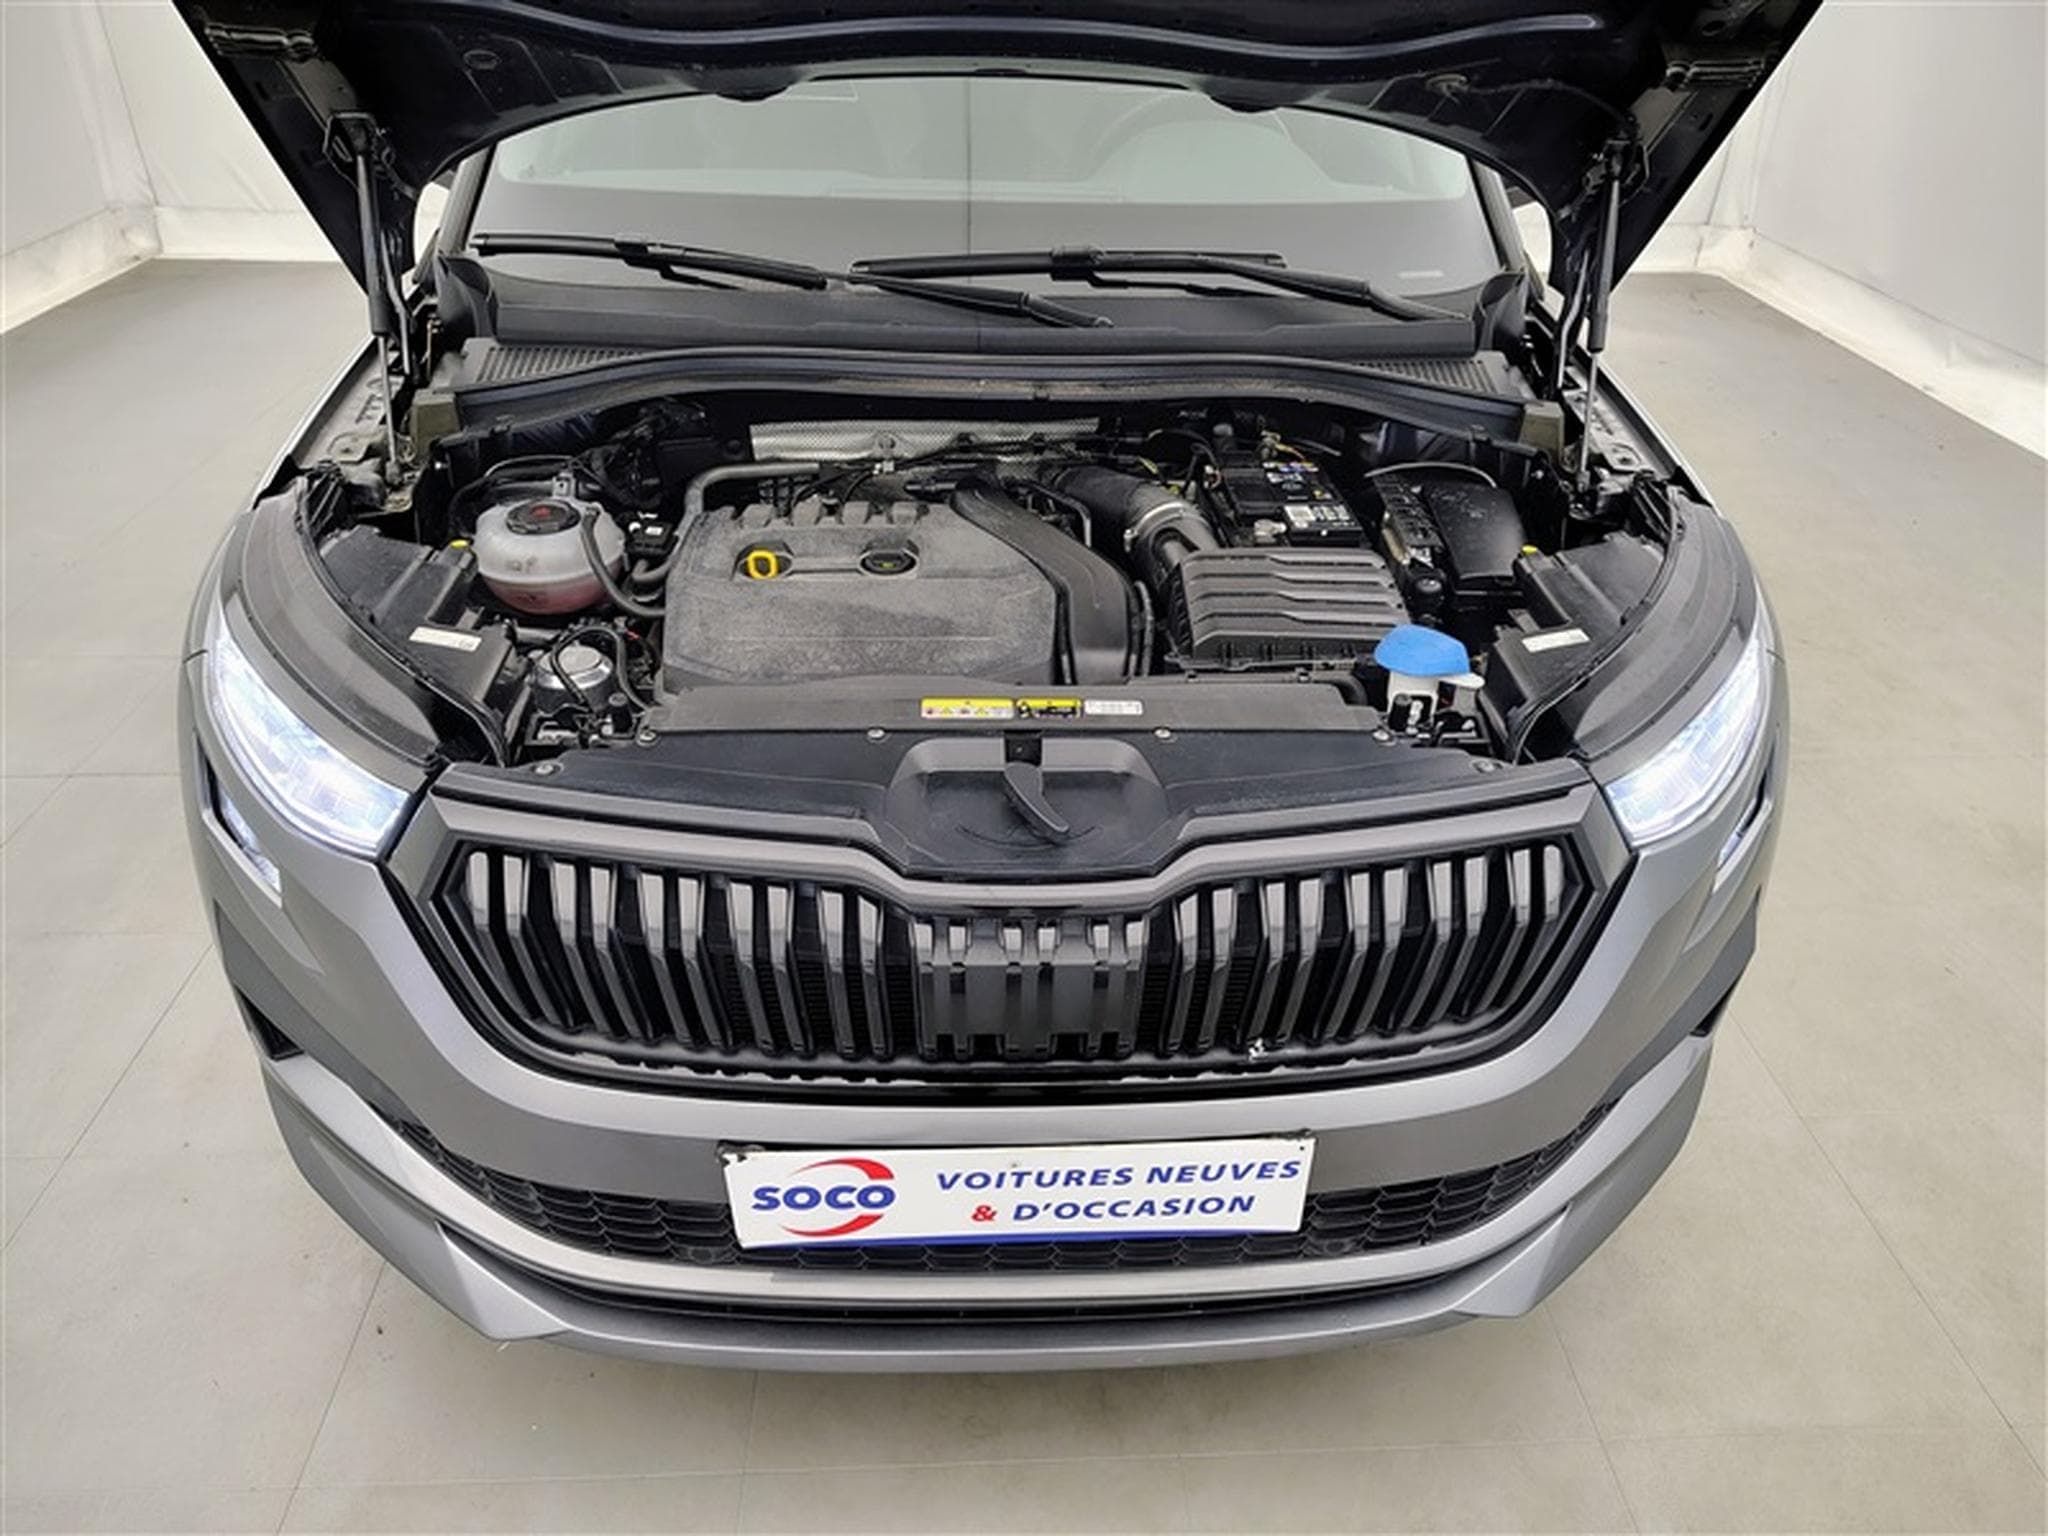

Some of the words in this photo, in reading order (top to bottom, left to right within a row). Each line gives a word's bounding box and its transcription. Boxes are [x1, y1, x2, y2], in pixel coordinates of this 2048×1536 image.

[937, 1165, 1133, 1191] VOITURES
[1146, 1160, 1300, 1184] NEUVES
[751, 1184, 896, 1212] SOCO
[971, 1205, 998, 1223] &
[1012, 1195, 1255, 1222] D'OCCASION
